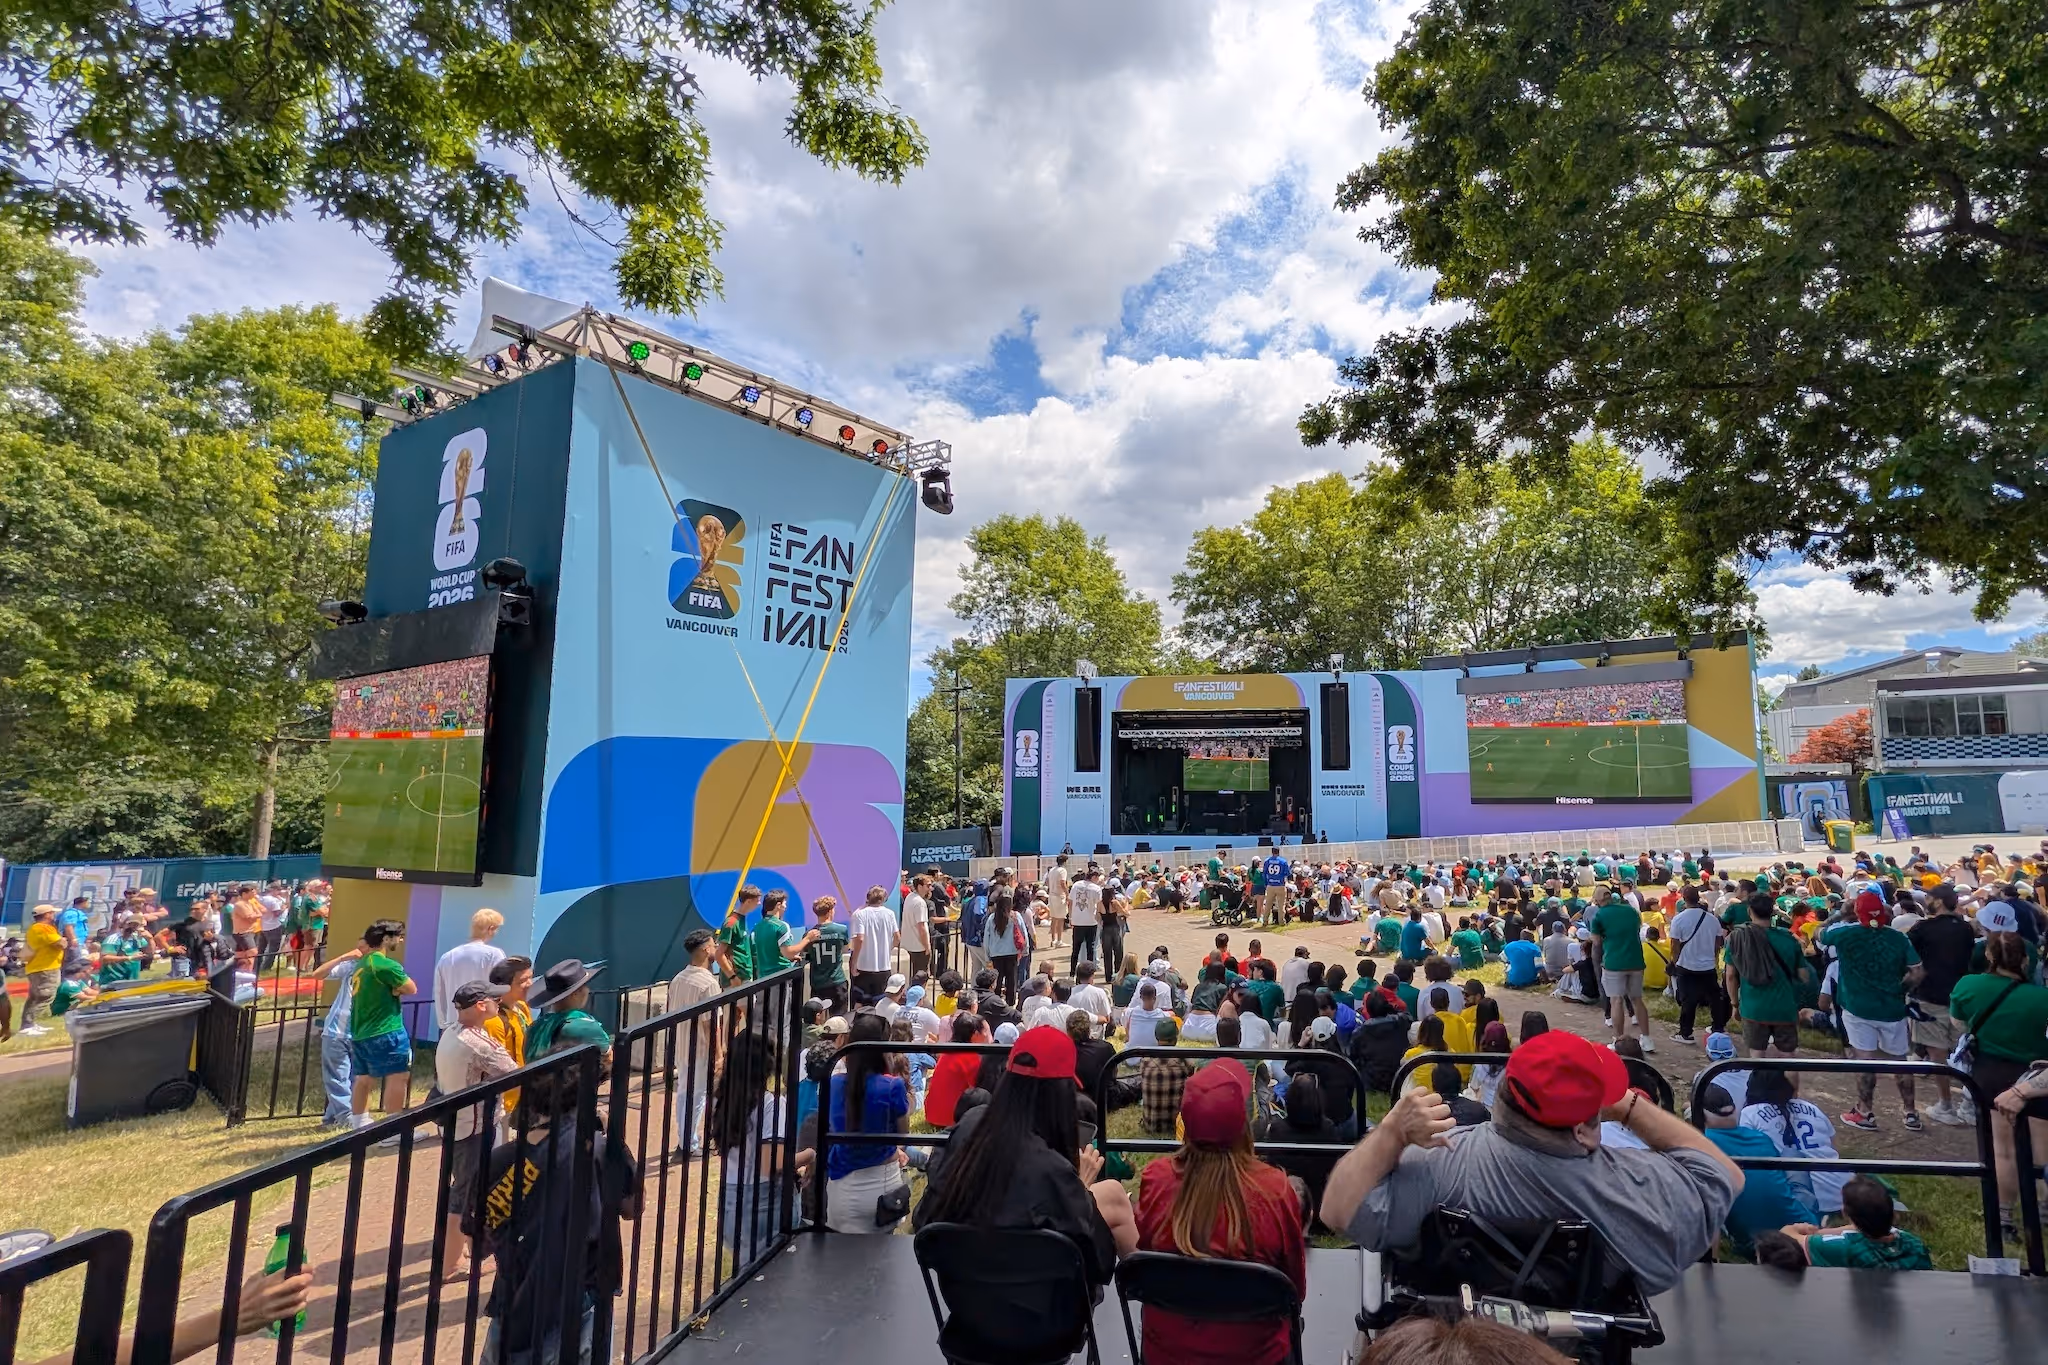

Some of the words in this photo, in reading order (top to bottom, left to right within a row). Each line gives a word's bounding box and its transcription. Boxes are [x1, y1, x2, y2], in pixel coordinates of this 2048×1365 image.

[446, 540, 465, 557] FIFA
[769, 522, 783, 558] FIFA
[785, 524, 854, 574] FAN
[430, 573, 458, 591] WORLD
[459, 570, 476, 584] CUP
[766, 562, 854, 614] FEST
[689, 591, 723, 610] FIFA
[665, 617, 738, 638] VANCOUVER
[1184, 692, 1235, 701] VANCOUVER
[1555, 796, 1594, 805] Hisense
[911, 848, 917, 856] A
[917, 845, 962, 855] FORCE
[962, 845, 974, 853] OF
[911, 853, 973, 864] NATURE
[375, 867, 404, 881] Hisense
[1268, 864, 1281, 875] 69
[812, 942, 837, 965] 14
